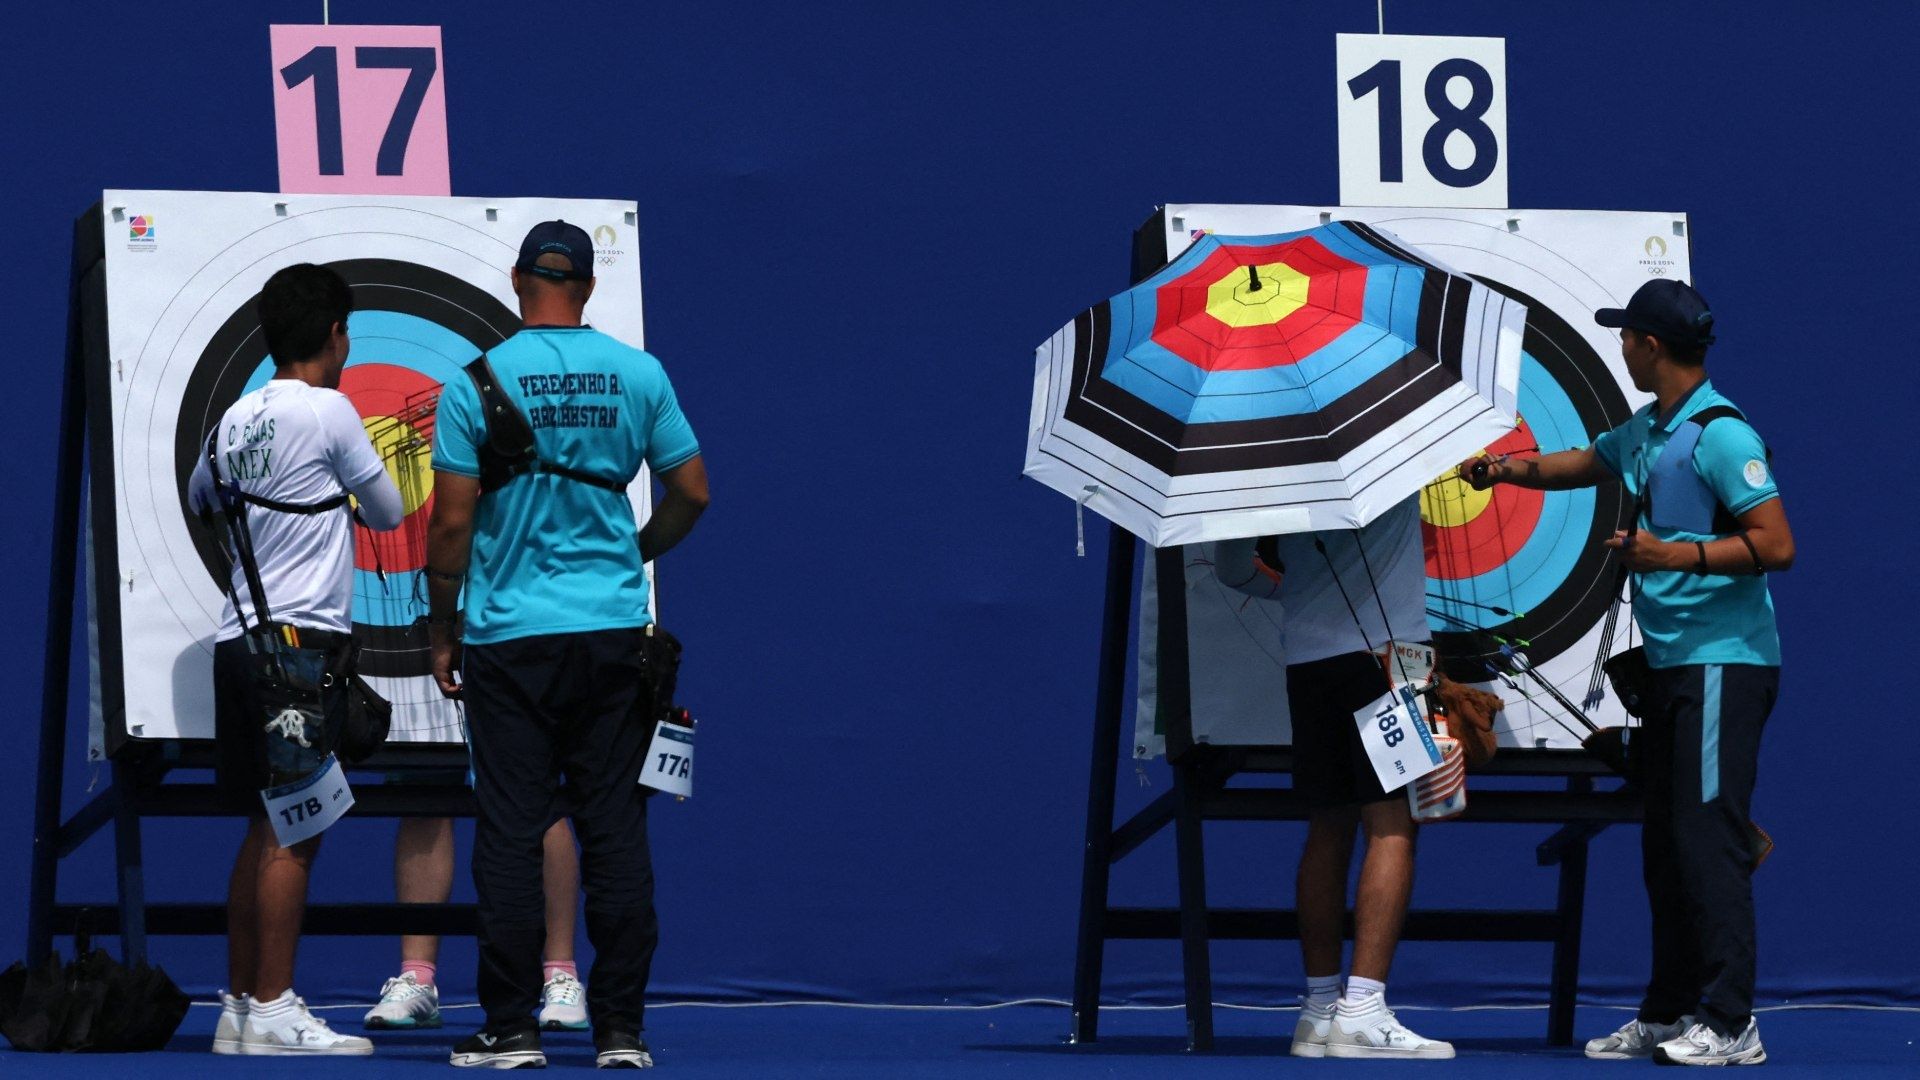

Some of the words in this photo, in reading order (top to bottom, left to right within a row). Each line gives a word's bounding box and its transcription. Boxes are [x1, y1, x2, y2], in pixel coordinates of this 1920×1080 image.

[280, 46, 436, 176] 17
[1346, 57, 1499, 188] 18
[529, 405, 619, 430] KAZKHSTAN
[226, 448, 273, 480] MEX
[1376, 704, 1405, 748] 18B
[657, 752, 690, 779] 17A
[280, 797, 322, 826] 17B
